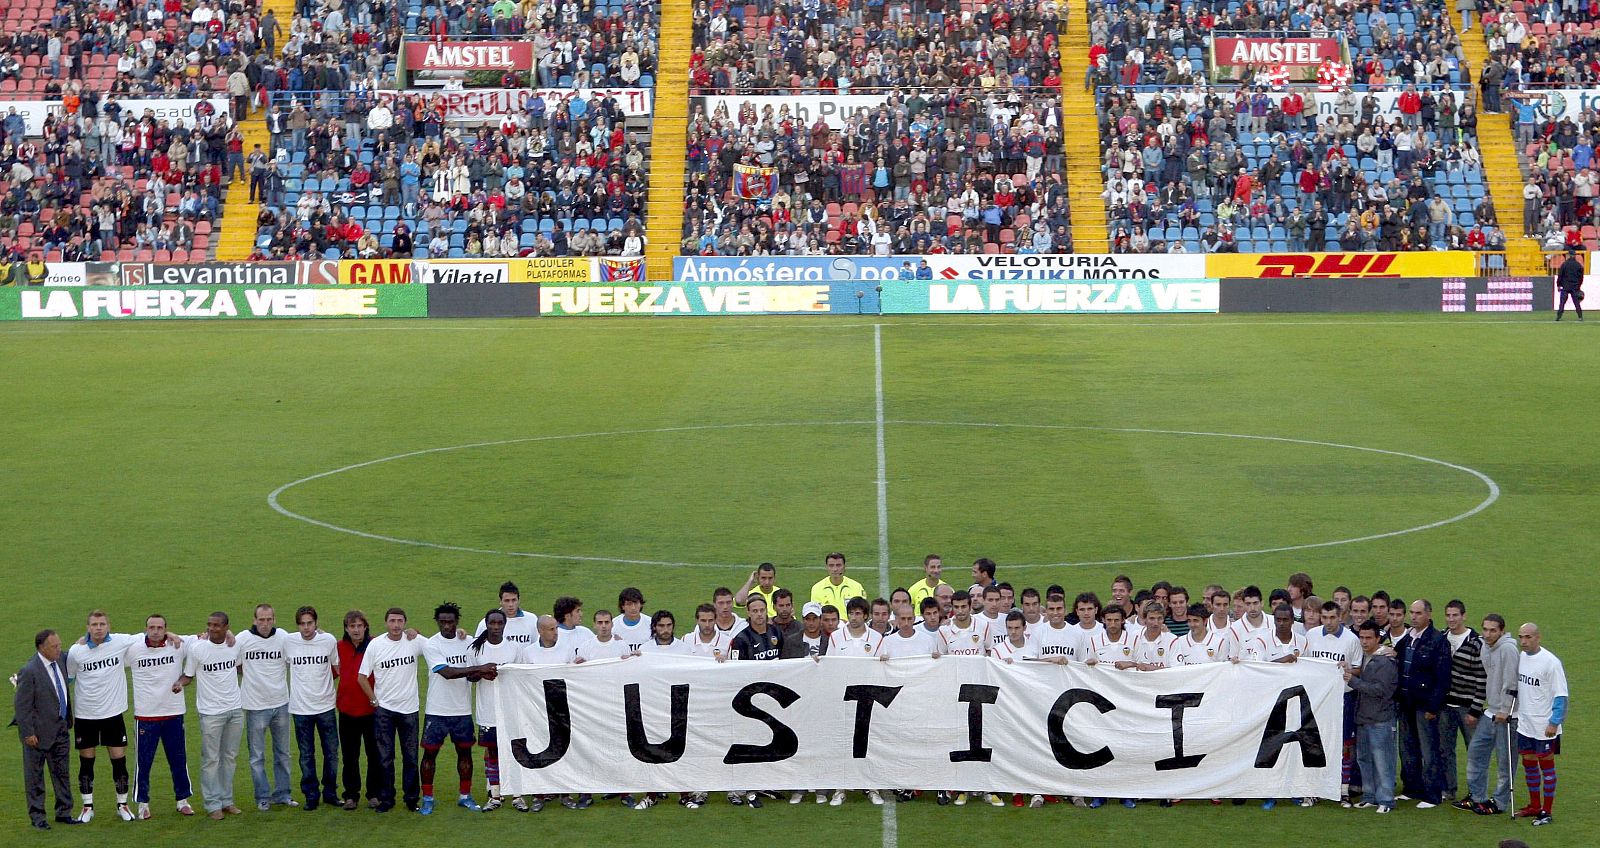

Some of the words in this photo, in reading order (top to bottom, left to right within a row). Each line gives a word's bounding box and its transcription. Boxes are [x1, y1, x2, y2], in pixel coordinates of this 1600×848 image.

[423, 44, 515, 69] AMSTEL
[1231, 40, 1322, 64] AMSTEL
[527, 259, 575, 268] ALQUILER
[976, 256, 1118, 267] VELOTURIA
[1256, 254, 1399, 278] DHL
[148, 263, 288, 285] Levantina
[432, 268, 503, 284] Vilatel
[527, 270, 588, 279] PLATAFORMAS
[680, 258, 823, 281] Atmósfera
[968, 269, 1074, 280] SUZUKI
[1083, 268, 1160, 280] MOTOS
[21, 290, 78, 318] LA
[82, 289, 238, 318] FUERZA
[245, 288, 378, 317] VEE
[540, 285, 692, 313] FUERZA
[698, 285, 831, 312] VEE
[930, 284, 985, 310] LA
[989, 283, 1144, 310] FUERZA
[245, 650, 283, 661] JUSTICIA
[951, 648, 979, 656] OYOTA
[1041, 645, 1075, 657] JUSTICIA
[83, 656, 120, 673] JUSTICIA
[138, 656, 176, 668] JUSTICIA
[203, 660, 237, 673] JUSTICIA
[293, 656, 329, 667] JUSTICIA
[382, 655, 416, 670] JUSTICIA
[1518, 673, 1541, 687] STICIA
[511, 679, 1327, 770] JUSTICIA
